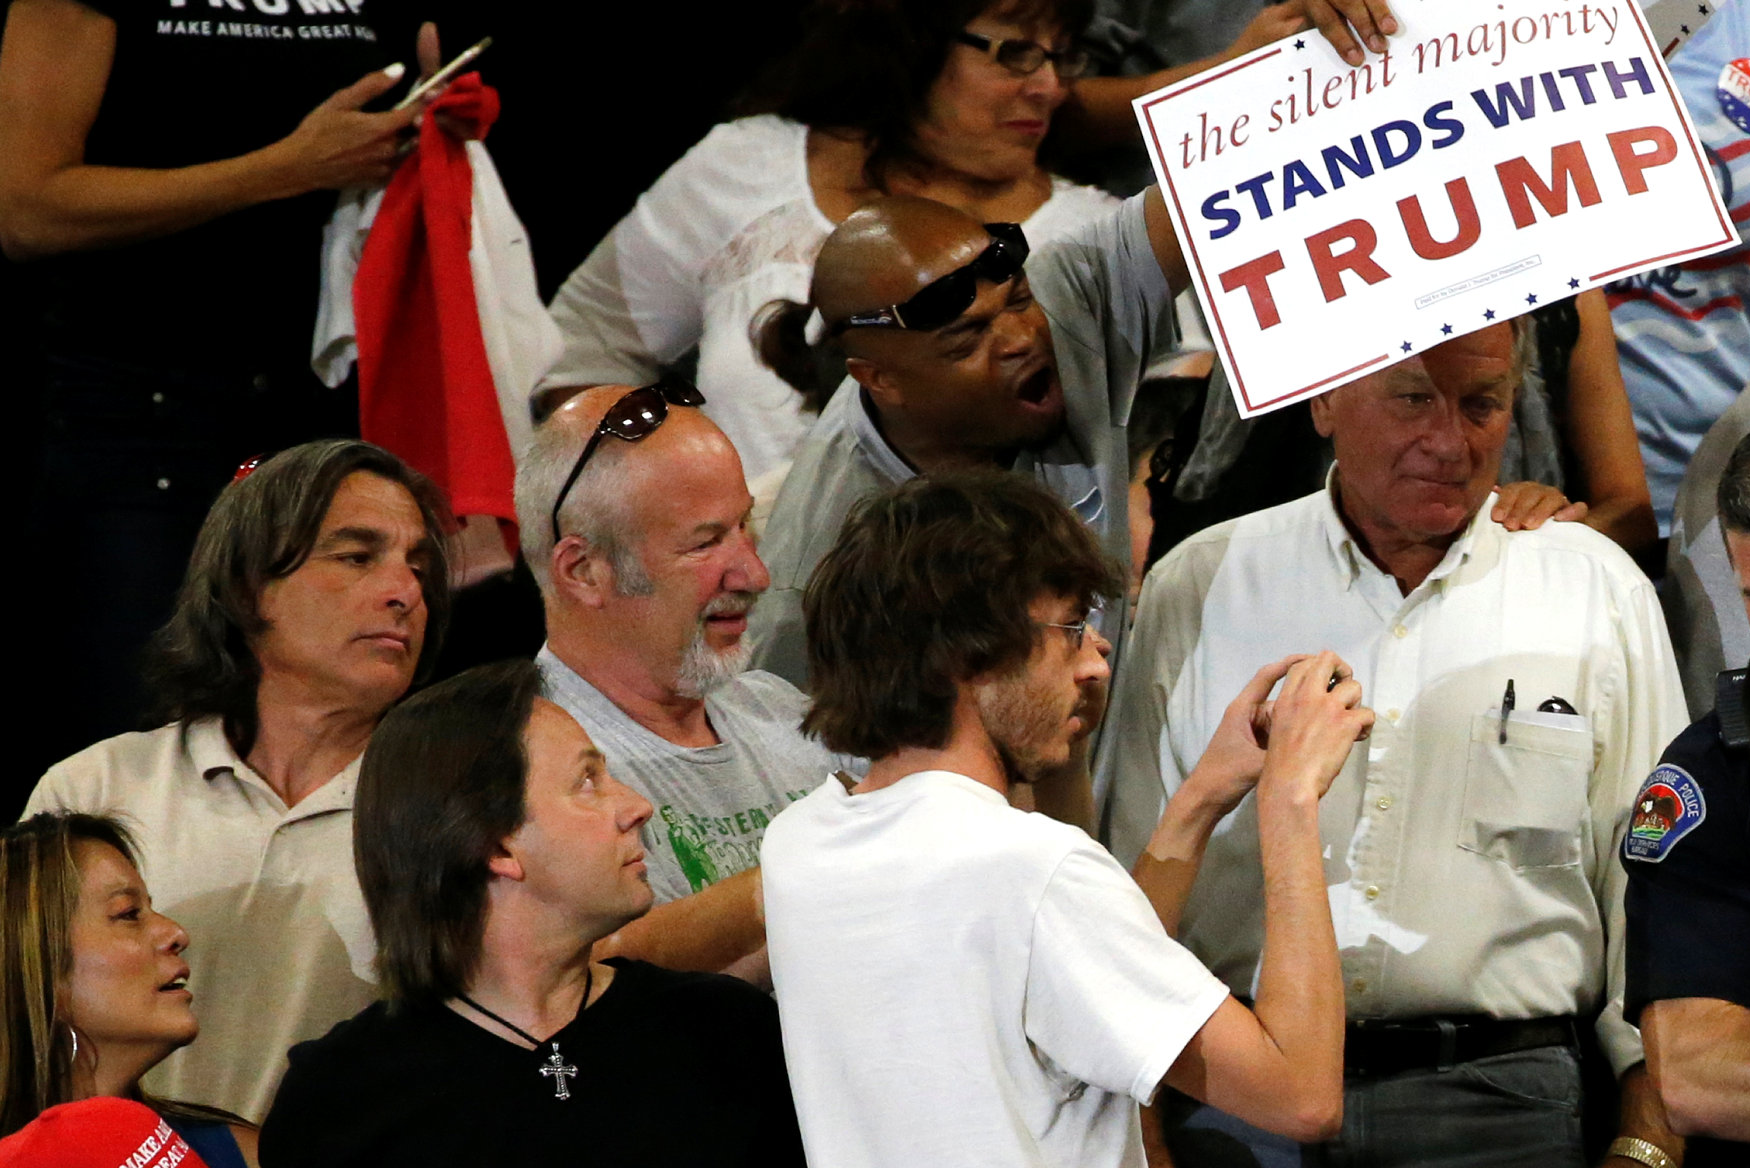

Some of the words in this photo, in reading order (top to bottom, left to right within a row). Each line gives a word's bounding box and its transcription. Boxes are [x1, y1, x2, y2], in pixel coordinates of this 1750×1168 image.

[157, 20, 211, 36] MAKE
[216, 22, 294, 39] AMERICA
[297, 24, 352, 39] GREAT
[1179, 112, 1250, 169] the
[1267, 50, 1397, 133] silent
[1412, 0, 1618, 74] majority
[1200, 101, 1465, 240] STANDS
[1470, 57, 1656, 130] WITH
[1218, 125, 1679, 331] TRUMP
[1679, 783, 1699, 818] POLICE
